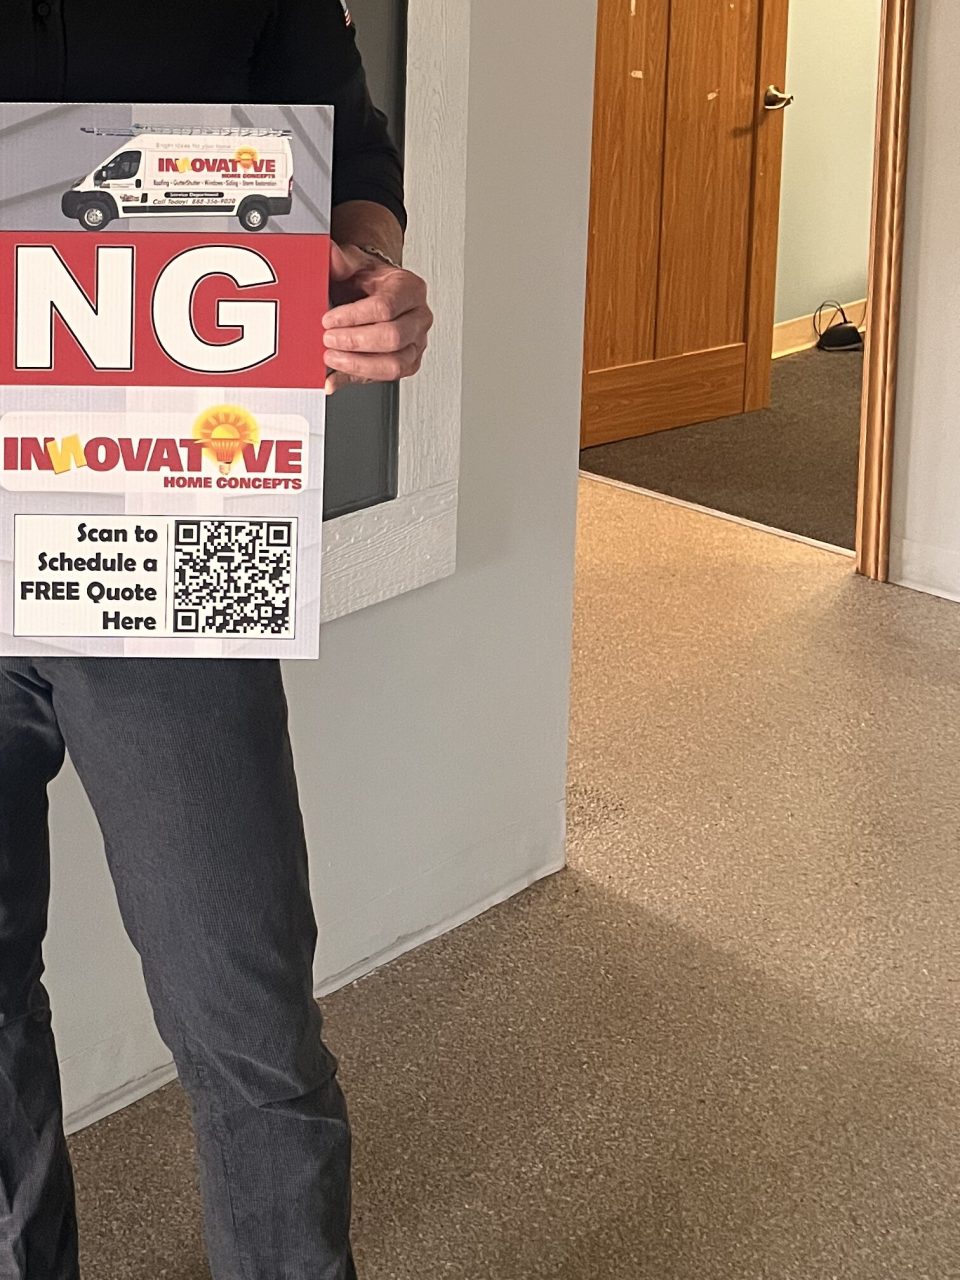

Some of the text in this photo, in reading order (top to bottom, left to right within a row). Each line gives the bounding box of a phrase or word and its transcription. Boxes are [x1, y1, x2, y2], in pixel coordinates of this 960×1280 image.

[168, 198, 188, 206] Today!
[163, 476, 302, 490] HOME CONCEPTS
[77, 522, 158, 542] Scan to
[38, 552, 158, 572] Schedule a
[20, 581, 157, 604] FREE Quote
[102, 611, 157, 630] Here
